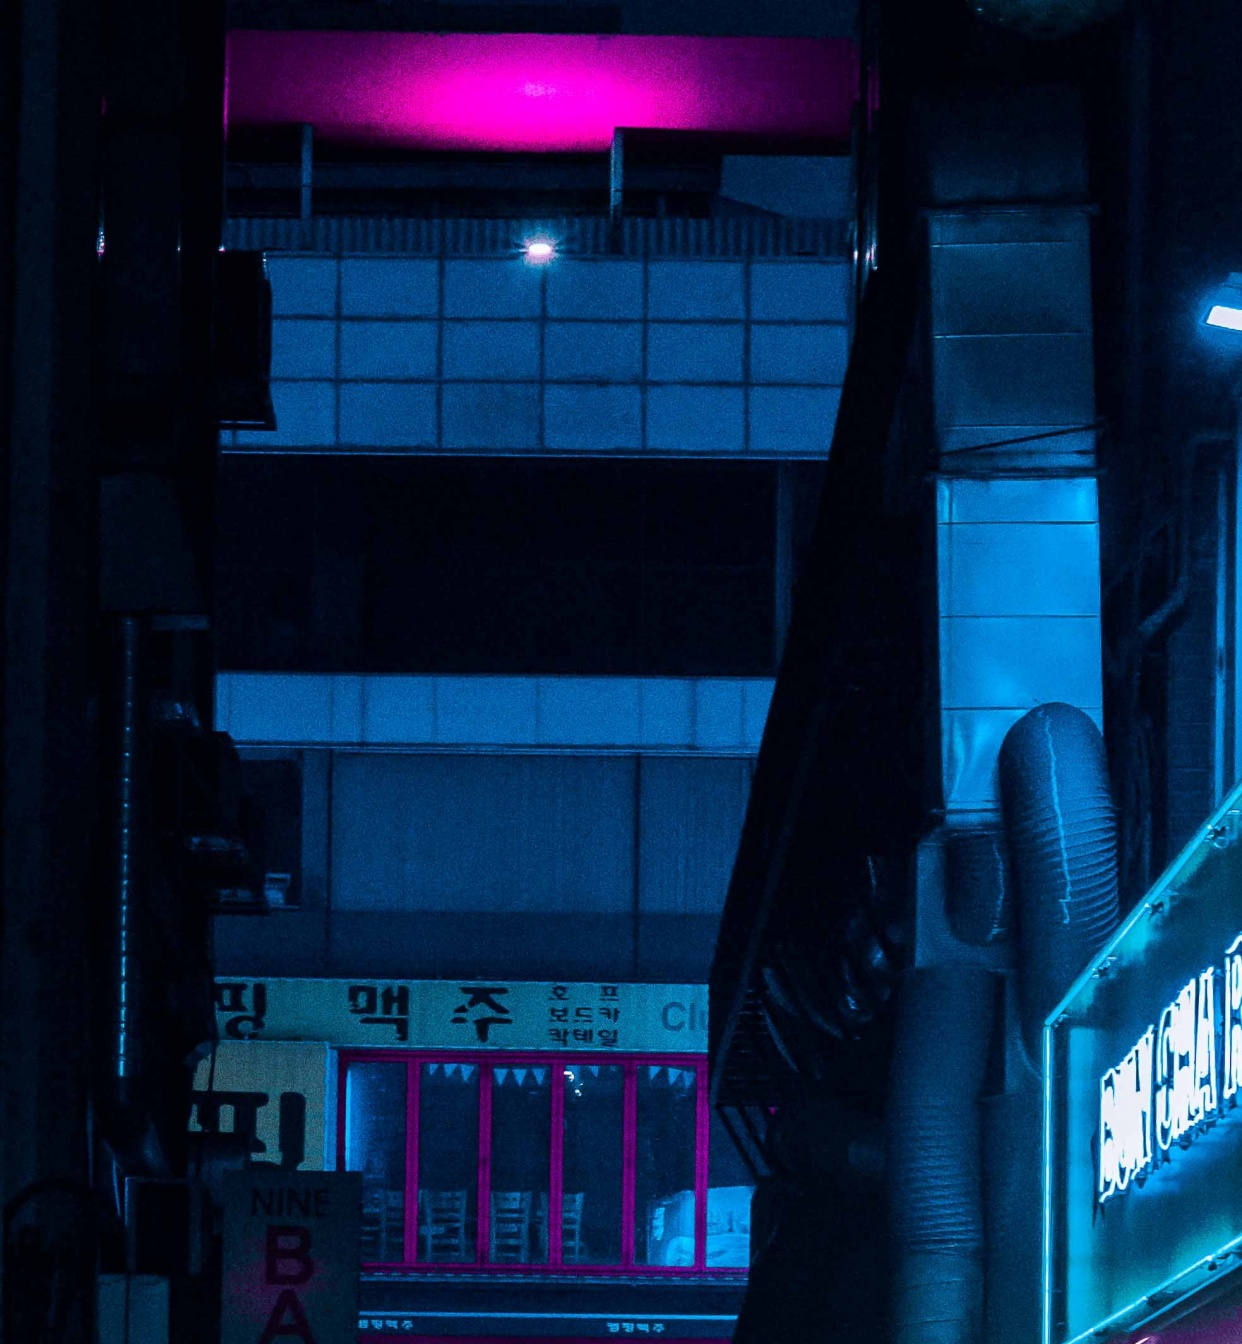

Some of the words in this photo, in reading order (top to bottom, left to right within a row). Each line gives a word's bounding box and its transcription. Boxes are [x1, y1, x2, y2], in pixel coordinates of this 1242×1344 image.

[549, 1006, 621, 1023] 보드카
[548, 1028, 619, 1047] 칵테일
[252, 1187, 330, 1218] NINE
